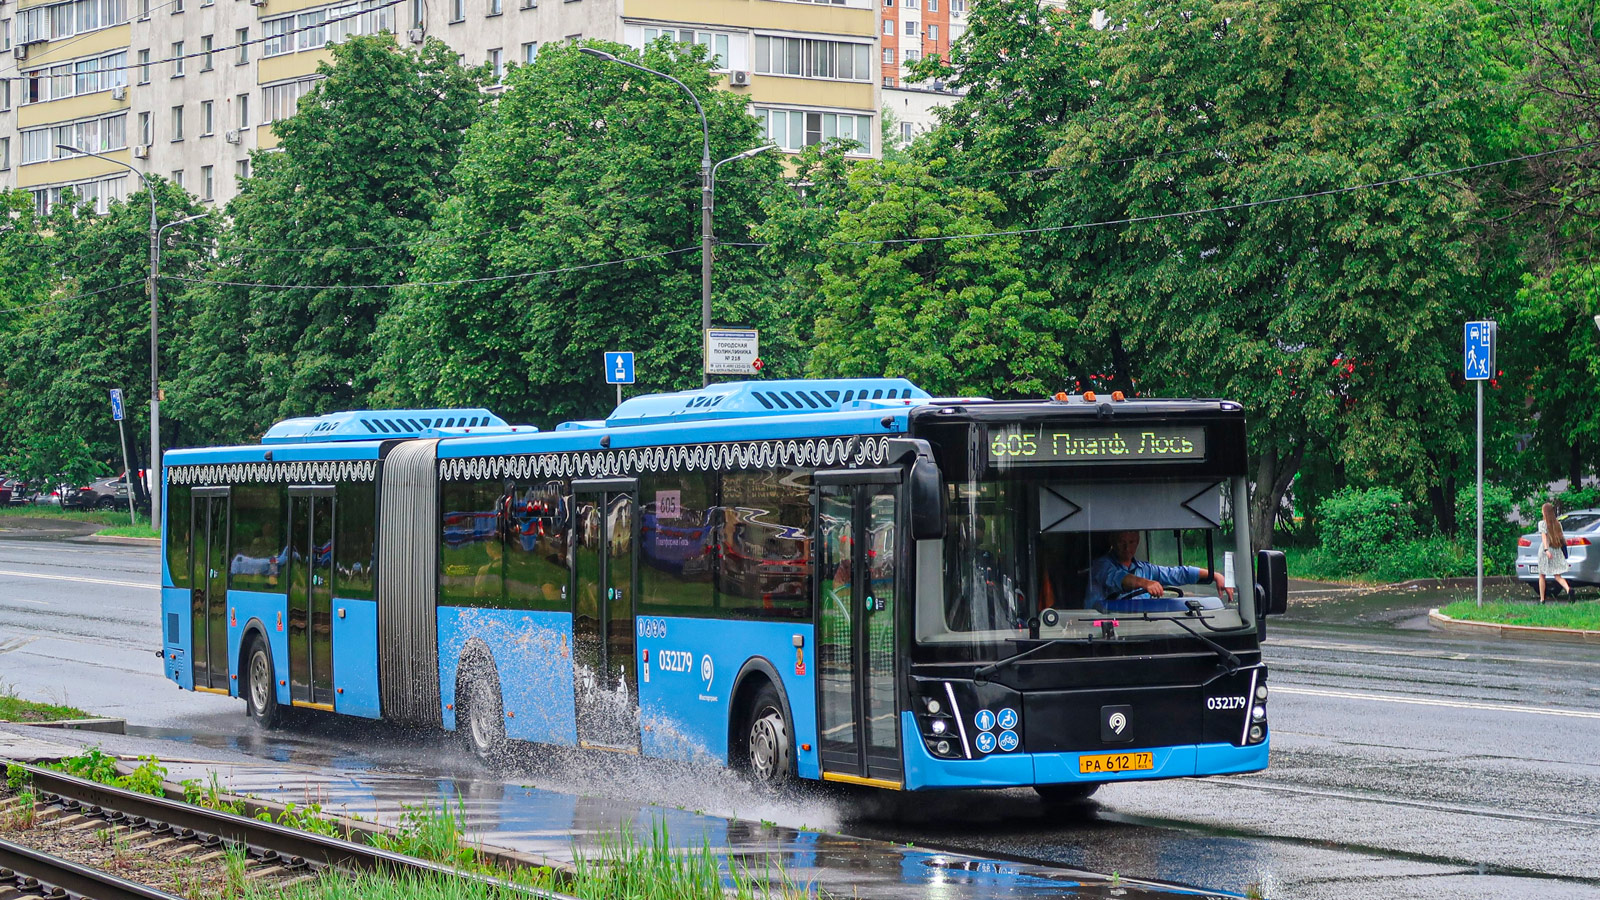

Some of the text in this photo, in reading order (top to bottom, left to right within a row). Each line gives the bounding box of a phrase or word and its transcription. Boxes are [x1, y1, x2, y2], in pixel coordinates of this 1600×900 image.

[991, 432, 1194, 456] 605 Платф. Лось
[660, 496, 676, 513] 605
[659, 650, 692, 672] 032179
[1207, 696, 1246, 710] 032179
[1106, 756, 1129, 769] 612
[1136, 754, 1148, 764] 77
